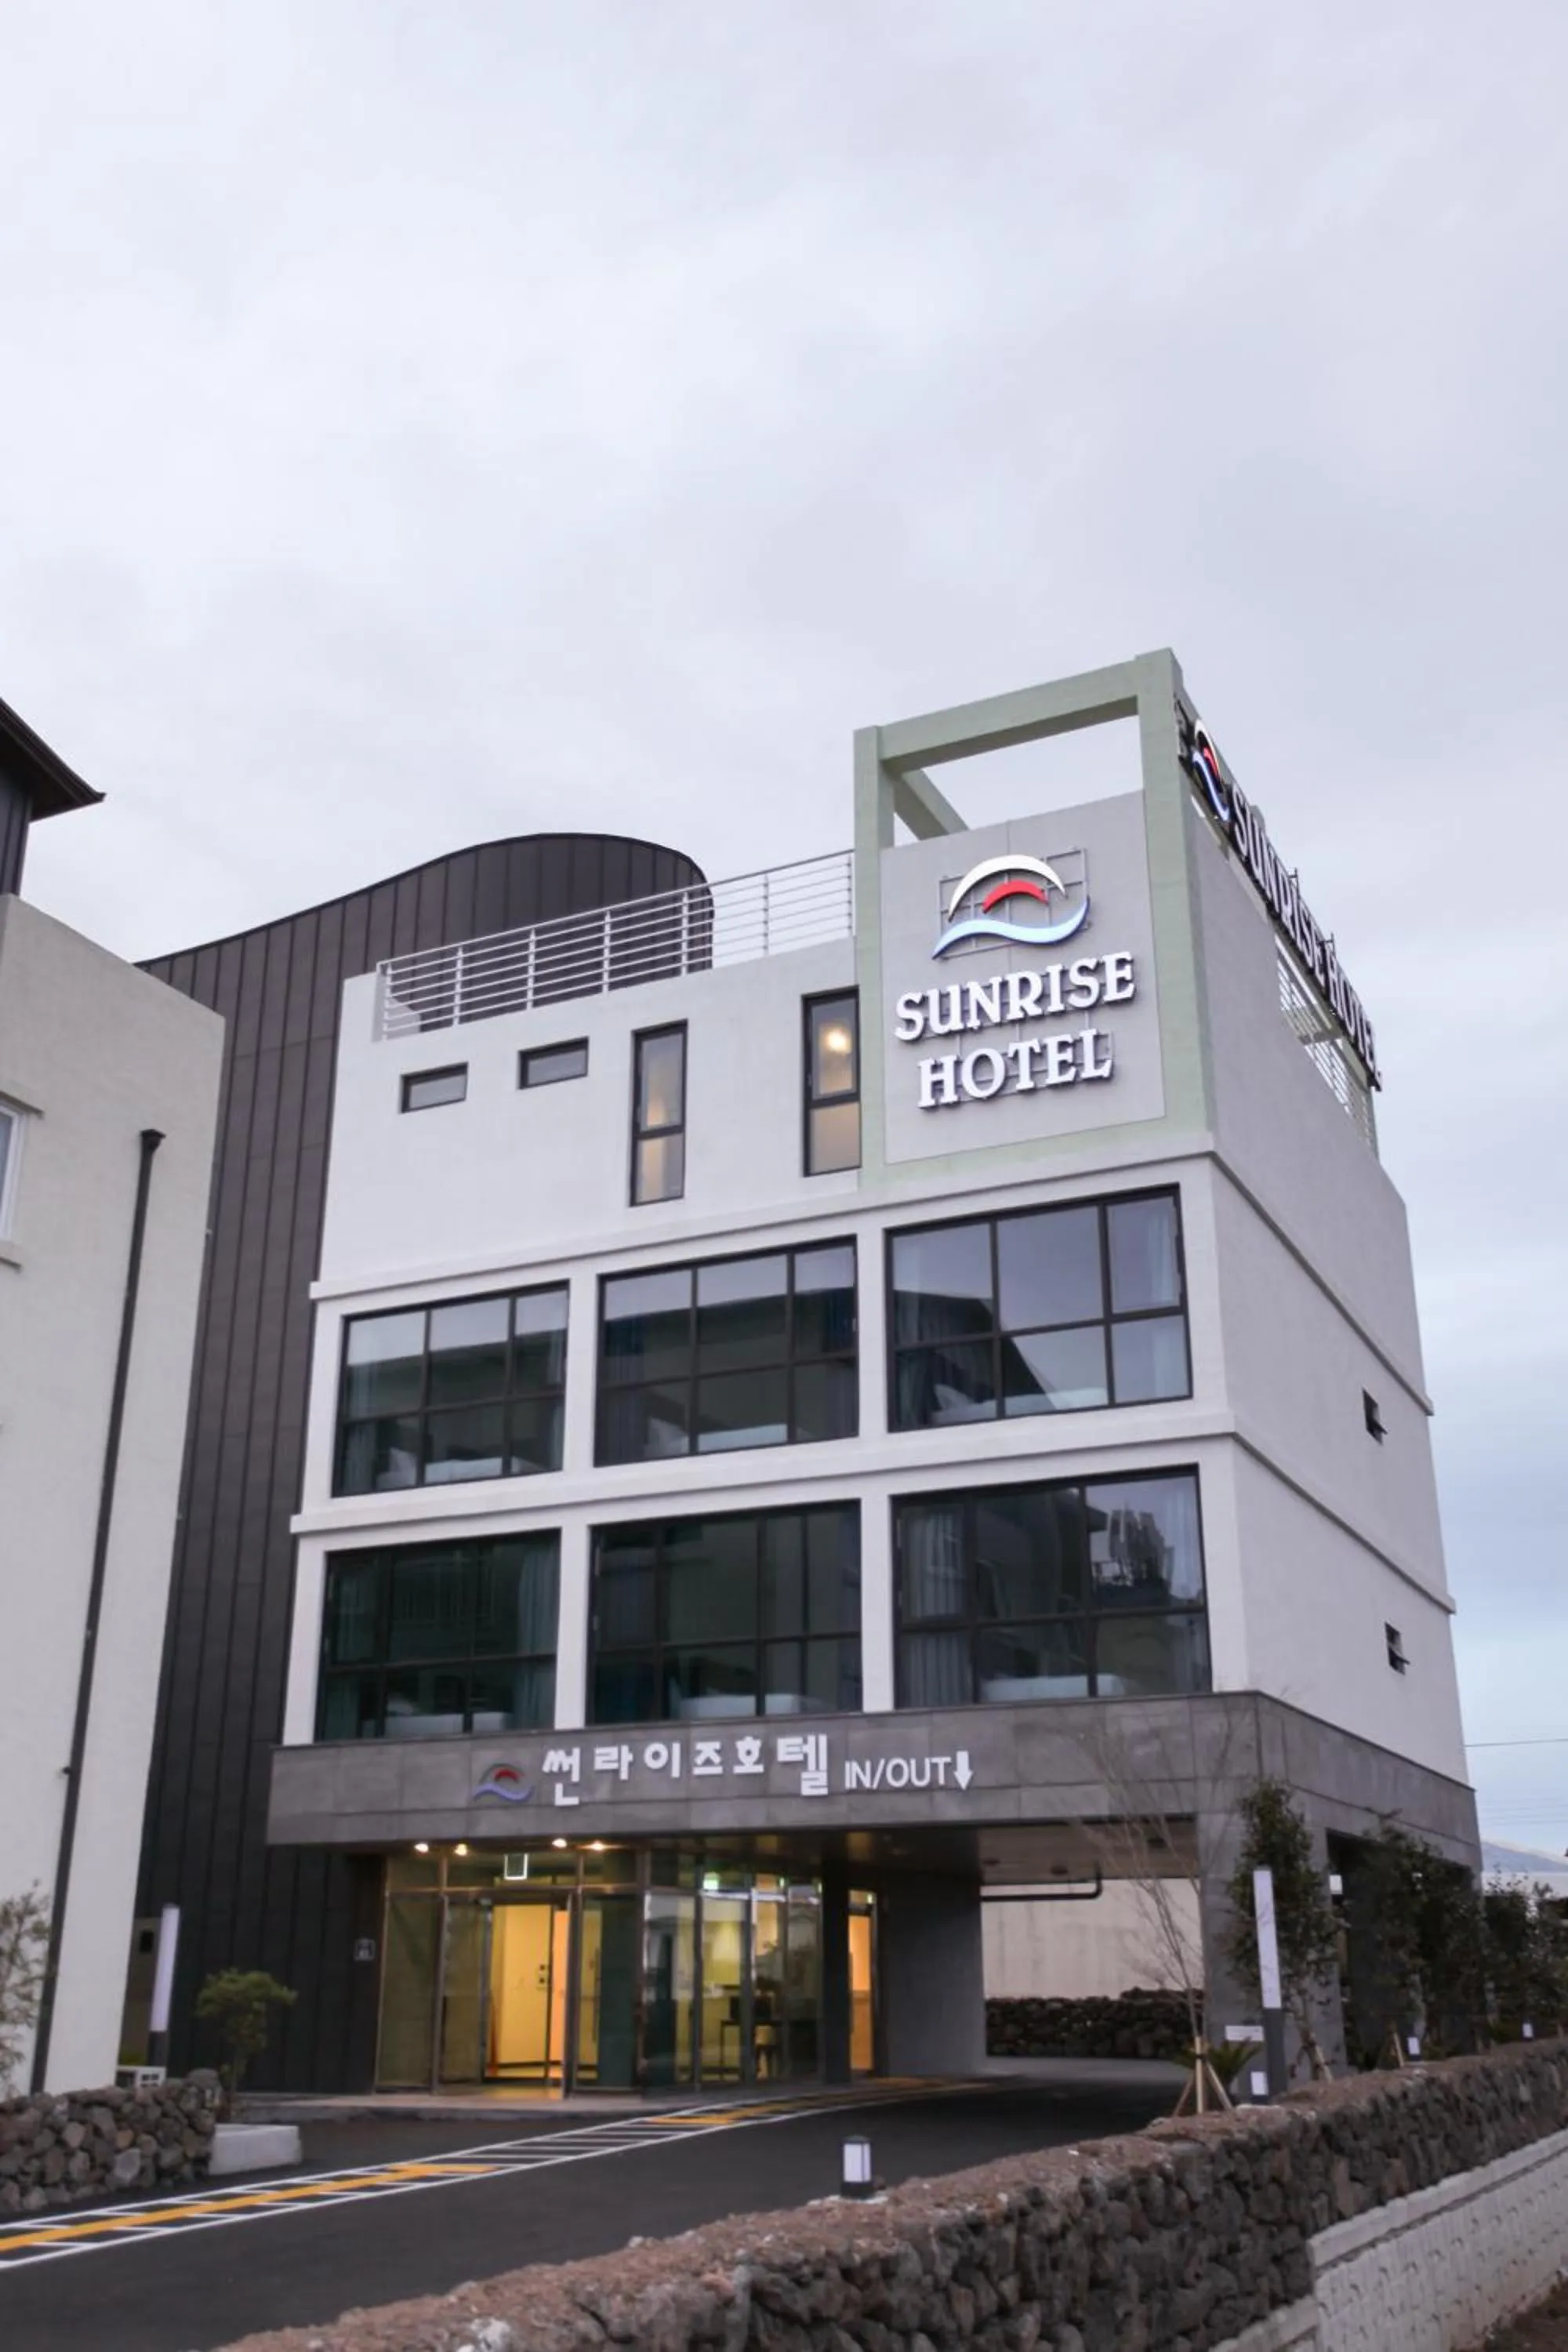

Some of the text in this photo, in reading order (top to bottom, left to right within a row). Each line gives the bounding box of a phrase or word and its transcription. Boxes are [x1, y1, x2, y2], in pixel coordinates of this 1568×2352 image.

[895, 951, 1135, 1041] SUNRISE
[917, 1028, 1113, 1109] HOTEL
[542, 1733, 952, 1806] 썬라이즈호텔 IN/OUT
